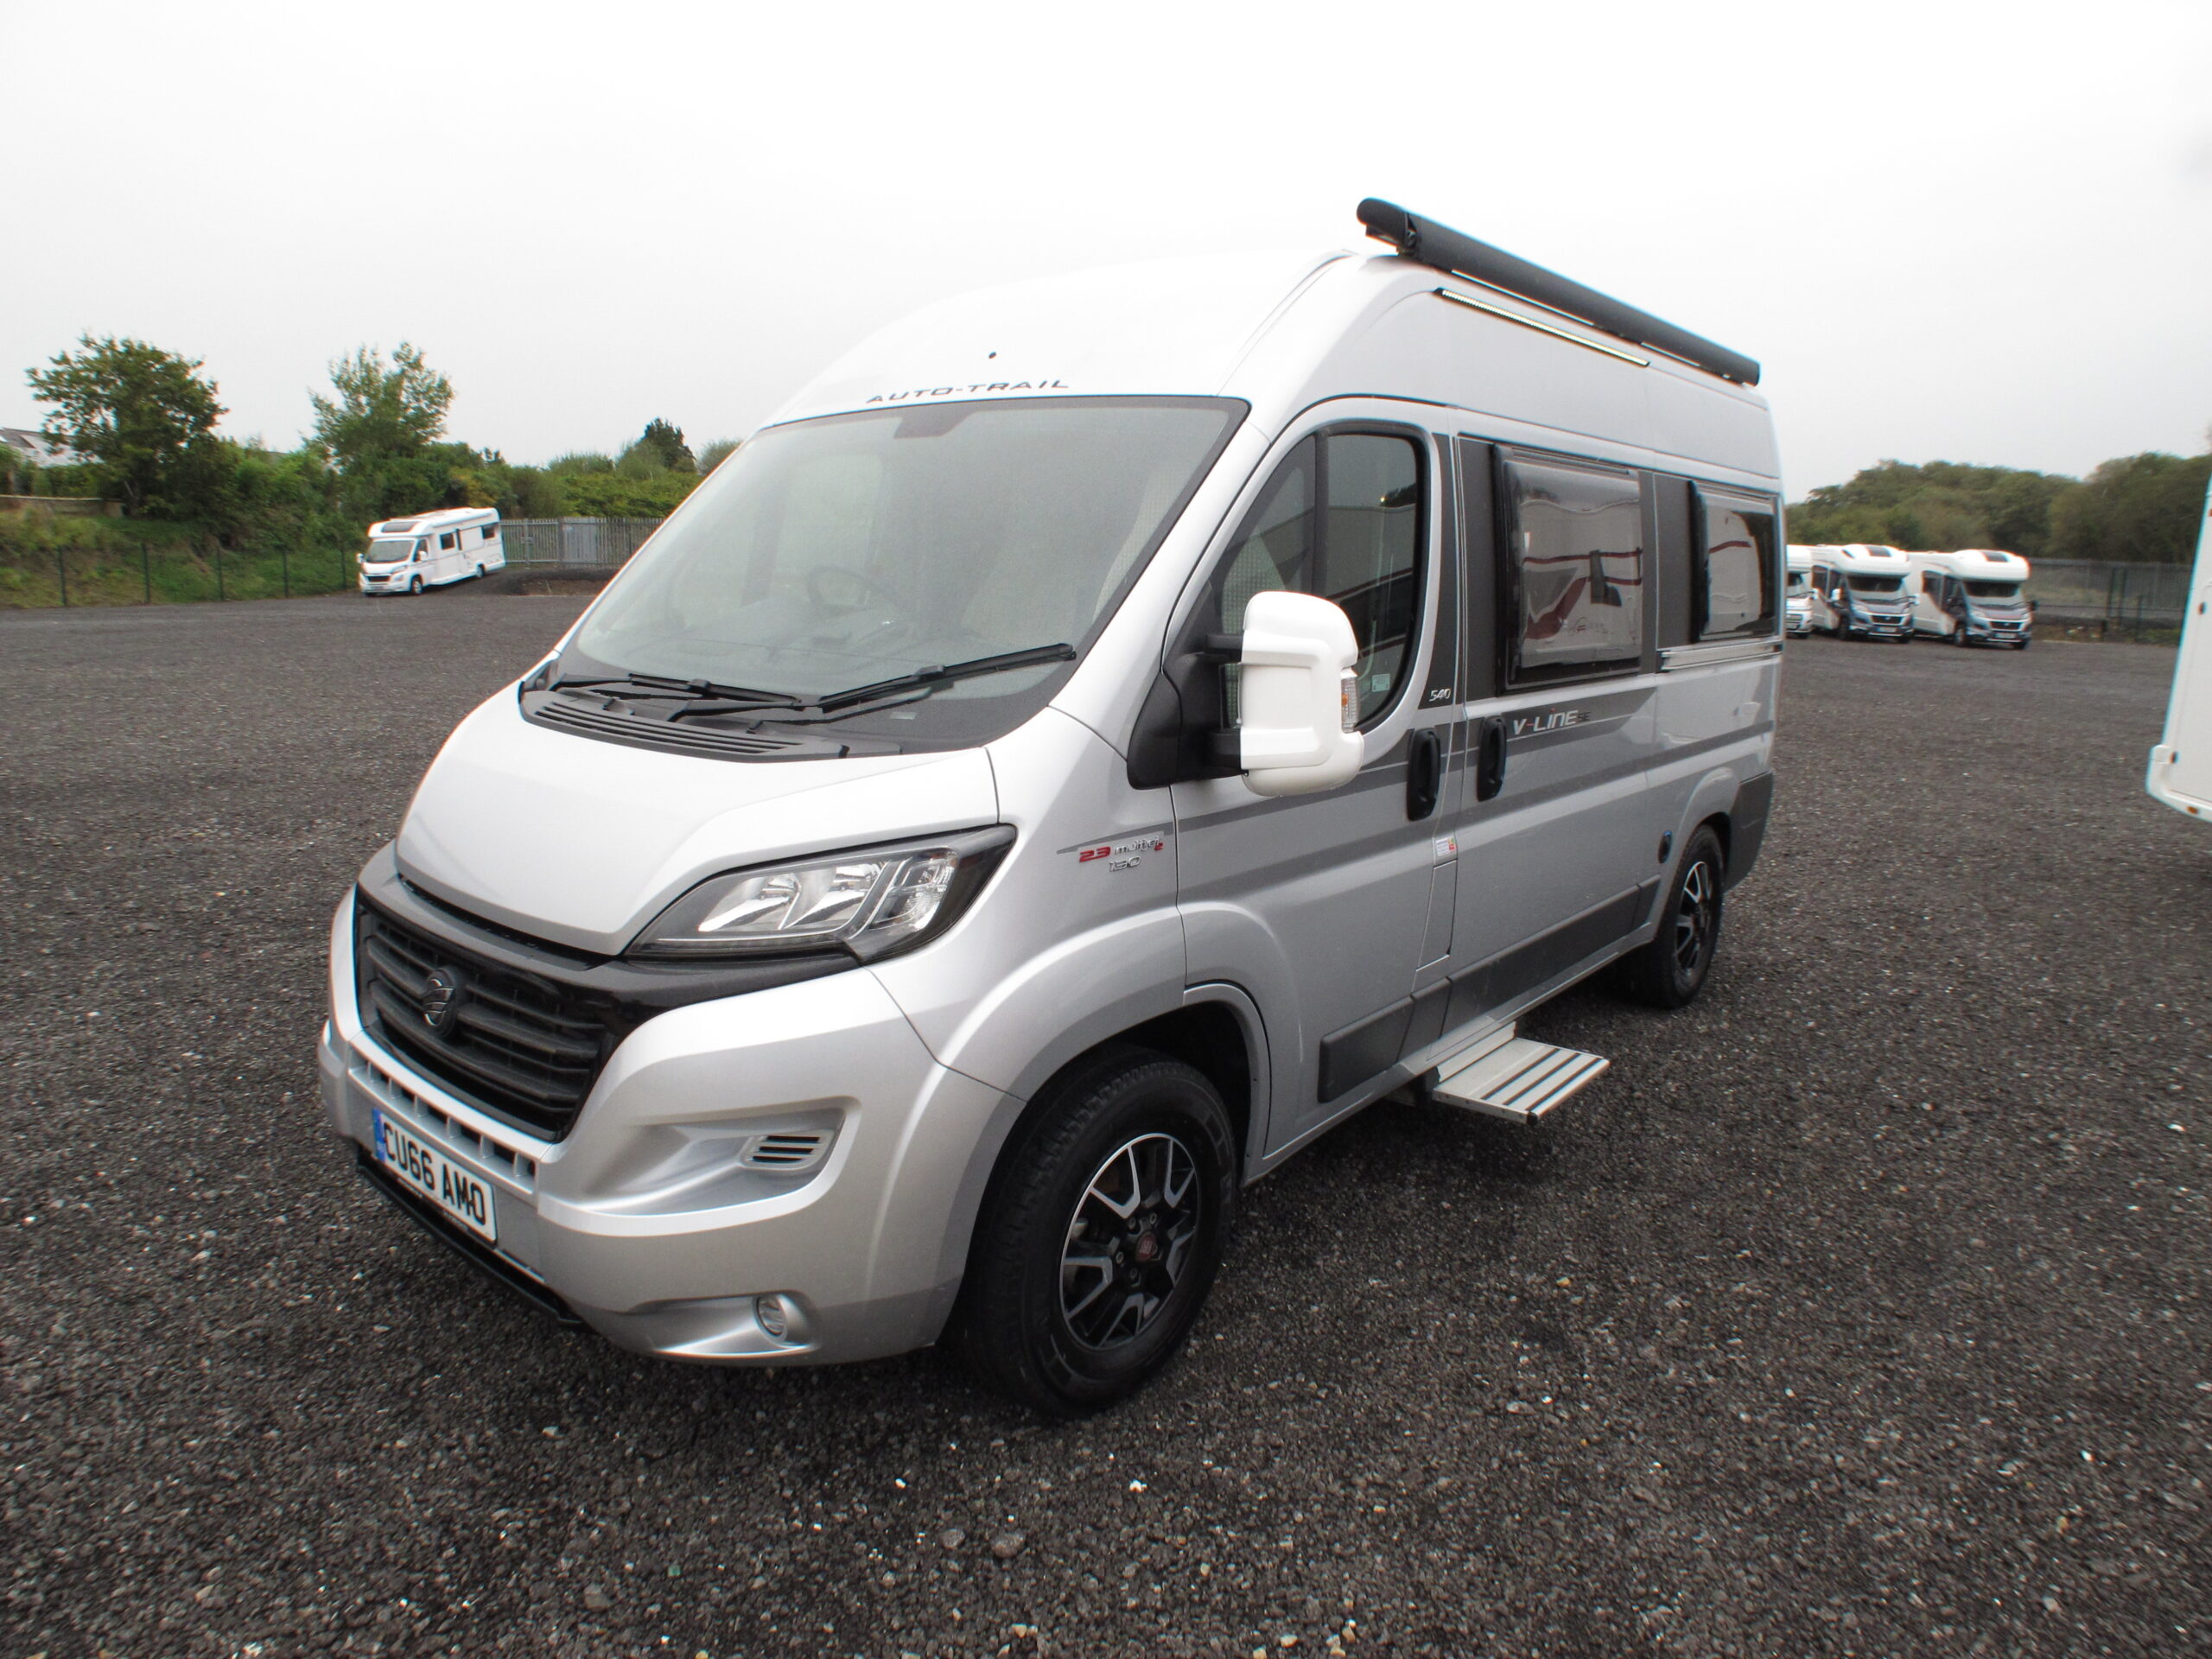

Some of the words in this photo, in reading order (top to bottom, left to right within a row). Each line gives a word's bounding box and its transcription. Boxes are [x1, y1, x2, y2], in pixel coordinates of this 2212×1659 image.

[866, 379, 1069, 404] AUTO-TRAIL
[1428, 688, 1452, 702] 540
[383, 1122, 435, 1192] CU66
[442, 1163, 487, 1226] AMO
